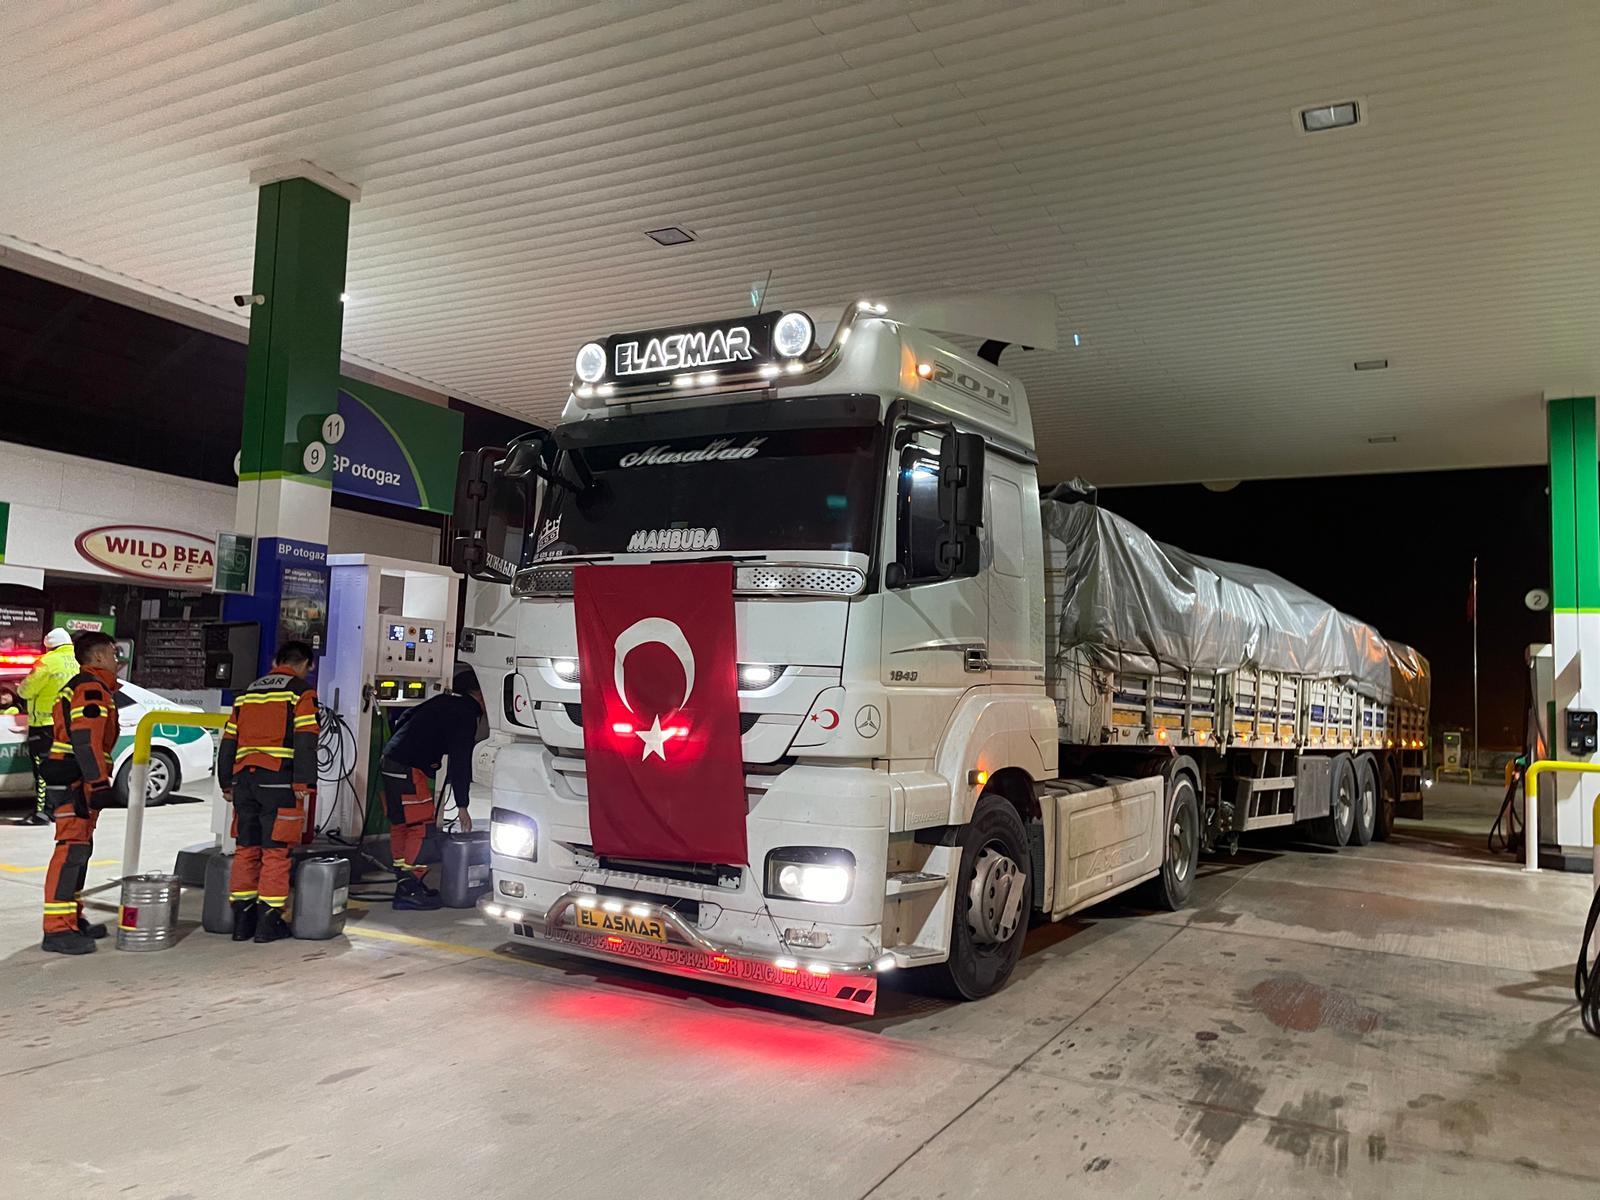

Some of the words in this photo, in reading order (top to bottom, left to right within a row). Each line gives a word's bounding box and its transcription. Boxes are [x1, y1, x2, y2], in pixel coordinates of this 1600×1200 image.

[327, 421, 340, 437] 11
[310, 449, 319, 465] 9
[351, 464, 401, 486] otogaz
[627, 527, 720, 552] MAHBUBA
[105, 536, 167, 559] WILD
[174, 546, 214, 566] BEA
[278, 544, 292, 555] BP
[293, 549, 326, 561] otogaz
[141, 559, 193, 574] CAFE
[1533, 595, 1542, 605] 2
[581, 910, 598, 926] EL
[602, 915, 661, 938] ASMAR
